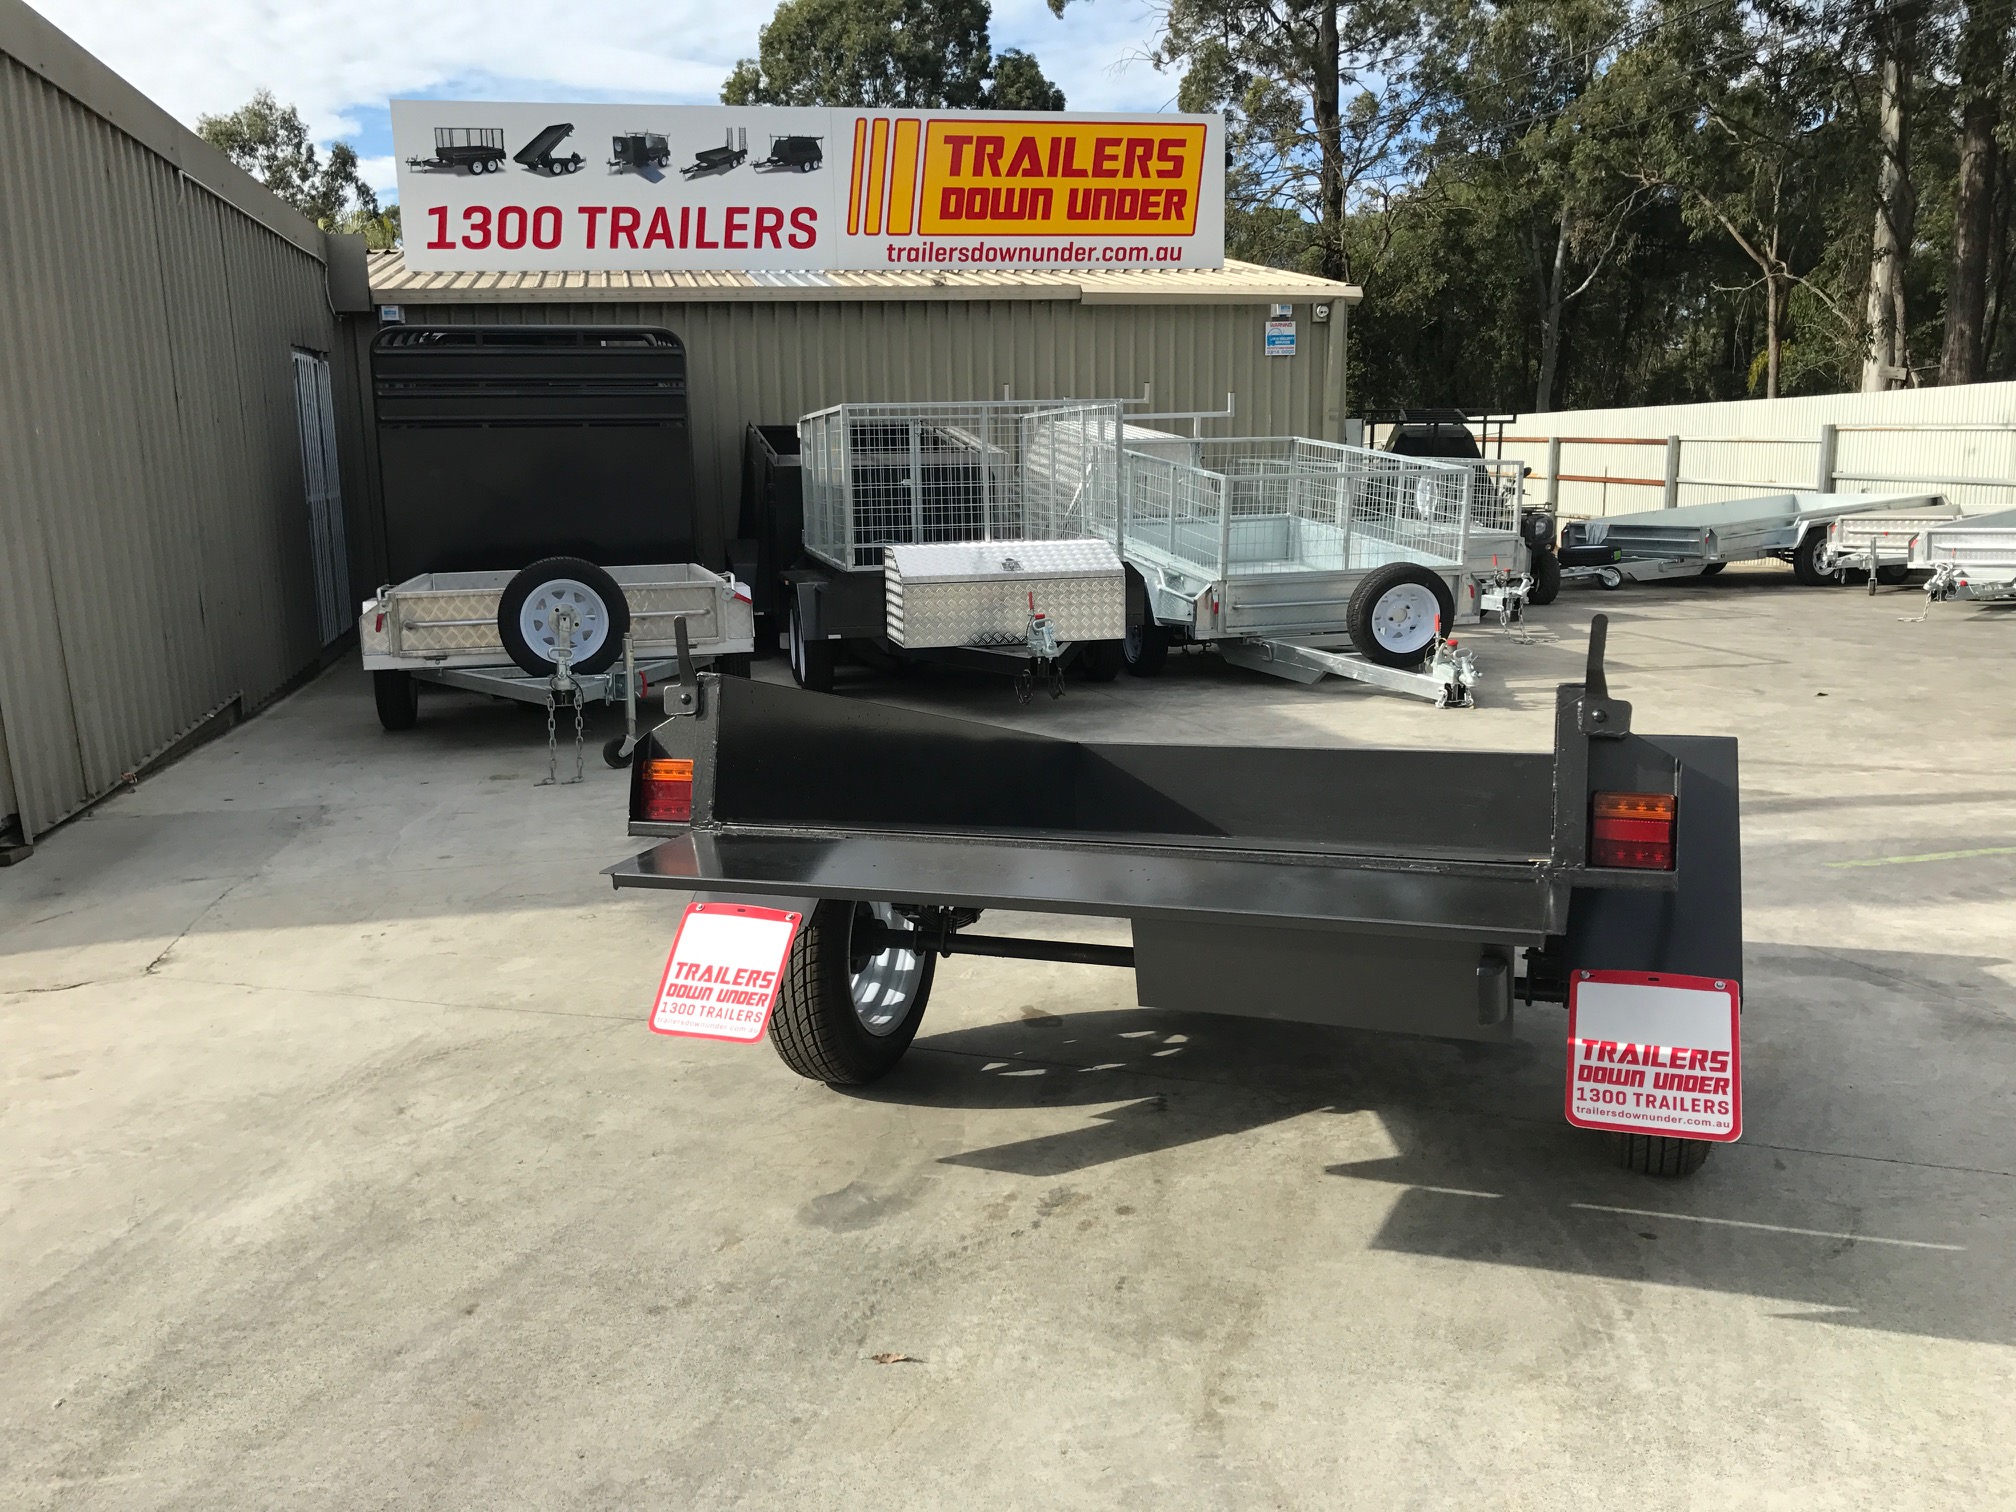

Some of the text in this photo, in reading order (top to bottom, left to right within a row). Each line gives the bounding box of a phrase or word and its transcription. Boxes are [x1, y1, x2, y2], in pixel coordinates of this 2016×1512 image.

[944, 135, 1187, 179] TRAILERS
[939, 187, 1188, 221] DOWN UNDER
[427, 205, 818, 250] 1300 TRAILERS
[887, 241, 1182, 263] trailersdownunder.com.au
[675, 962, 776, 989] TRAILERS
[666, 983, 769, 1007] DOWN UNDER
[657, 1017, 758, 1034] trailersdownundercomau
[660, 1002, 763, 1023] 1300 TRAILERS
[1581, 1039, 1730, 1073] TRAILERS
[1578, 1065, 1730, 1095] DOWN UNDER
[1577, 1087, 1729, 1115] 1300 TRAILERS
[1577, 1106, 1730, 1128] trailersdownunder.com.au
